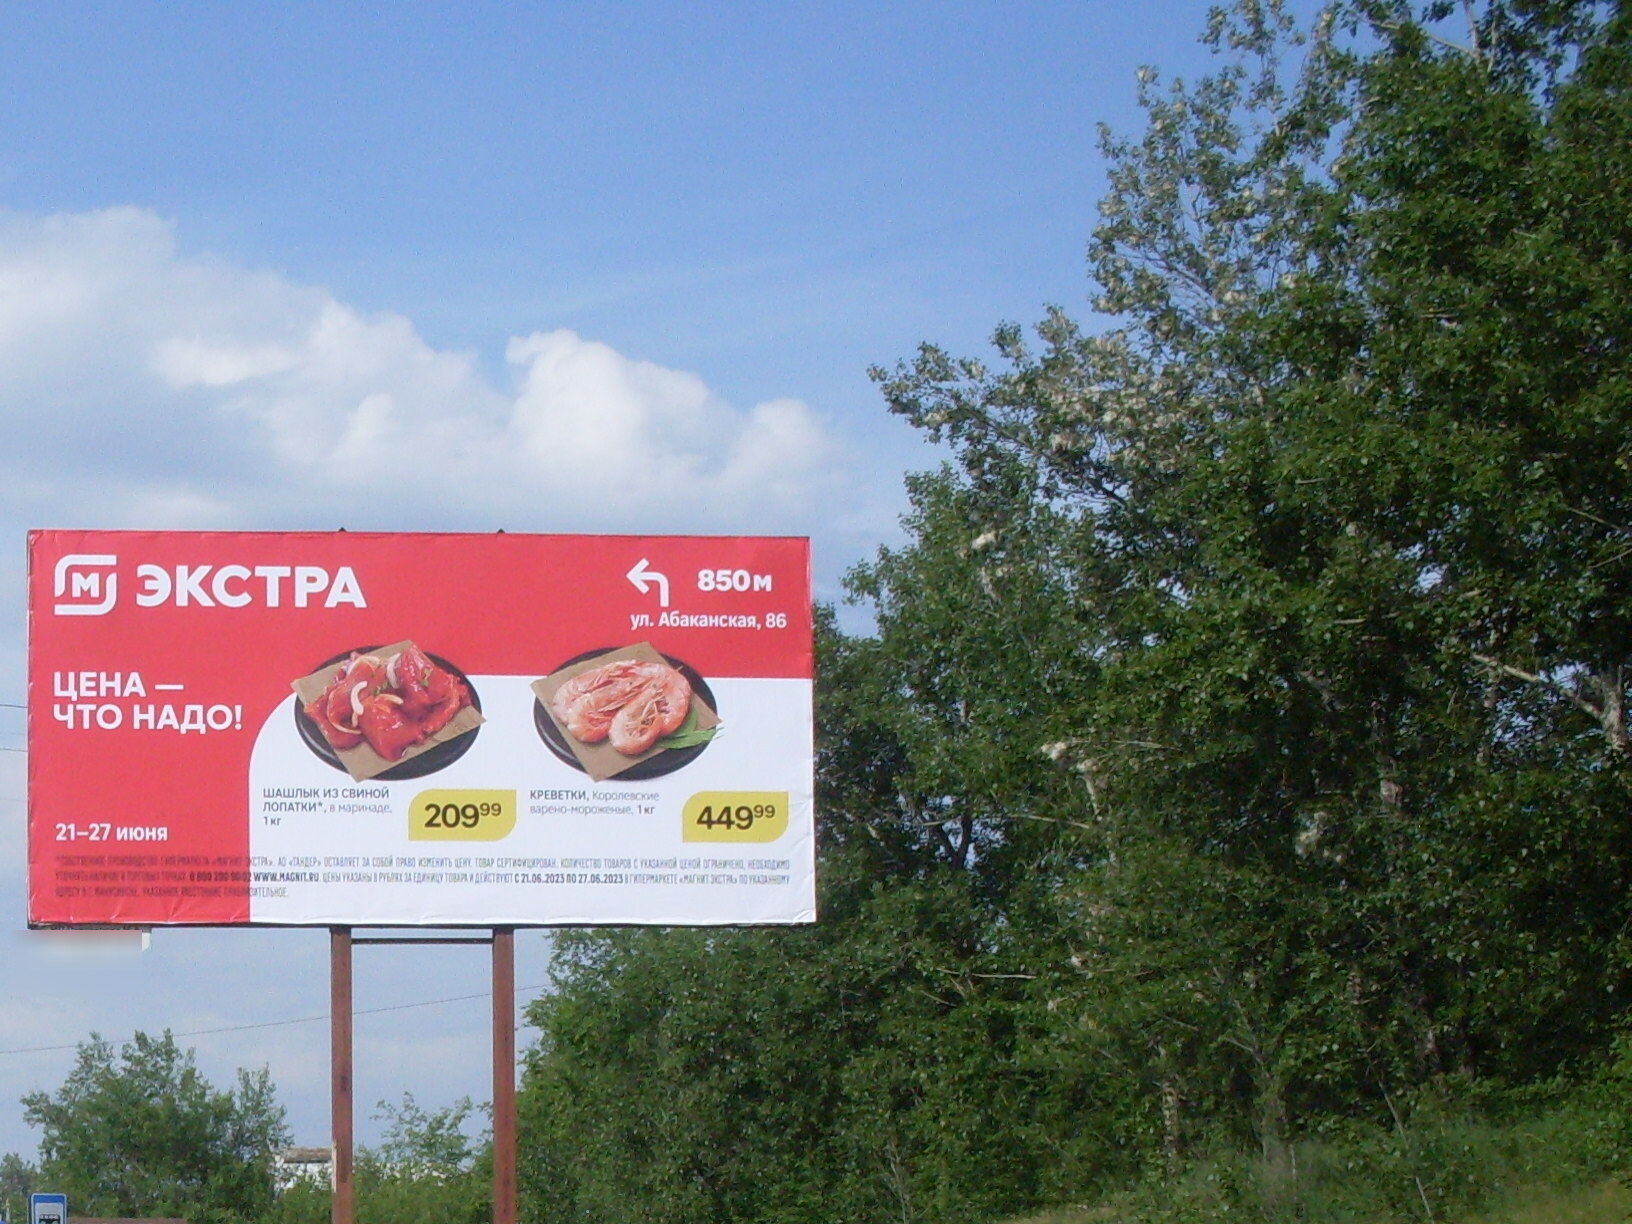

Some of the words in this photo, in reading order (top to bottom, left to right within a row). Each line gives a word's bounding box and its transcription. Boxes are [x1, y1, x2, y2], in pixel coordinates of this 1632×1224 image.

[136, 564, 367, 608] ЭКСТРА
[630, 613, 654, 630] ул.
[658, 611, 761, 630] Абаканская,
[765, 612, 787, 628] 86
[53, 671, 146, 701] ЦЕНА
[53, 704, 122, 730] ЧТО
[133, 704, 242, 734] НАДО!
[263, 787, 320, 799] ШАШЛЫК
[323, 788, 339, 799] ИЗ
[341, 786, 389, 799] СВИНОЙ
[530, 790, 590, 801] КРЕВЕТКИ,
[592, 790, 660, 801] Королевские
[329, 804, 335, 813] в
[116, 826, 168, 841] июня
[521, 873, 565, 884] 21.06.2023
[578, 873, 623, 884] 27.06.2023
